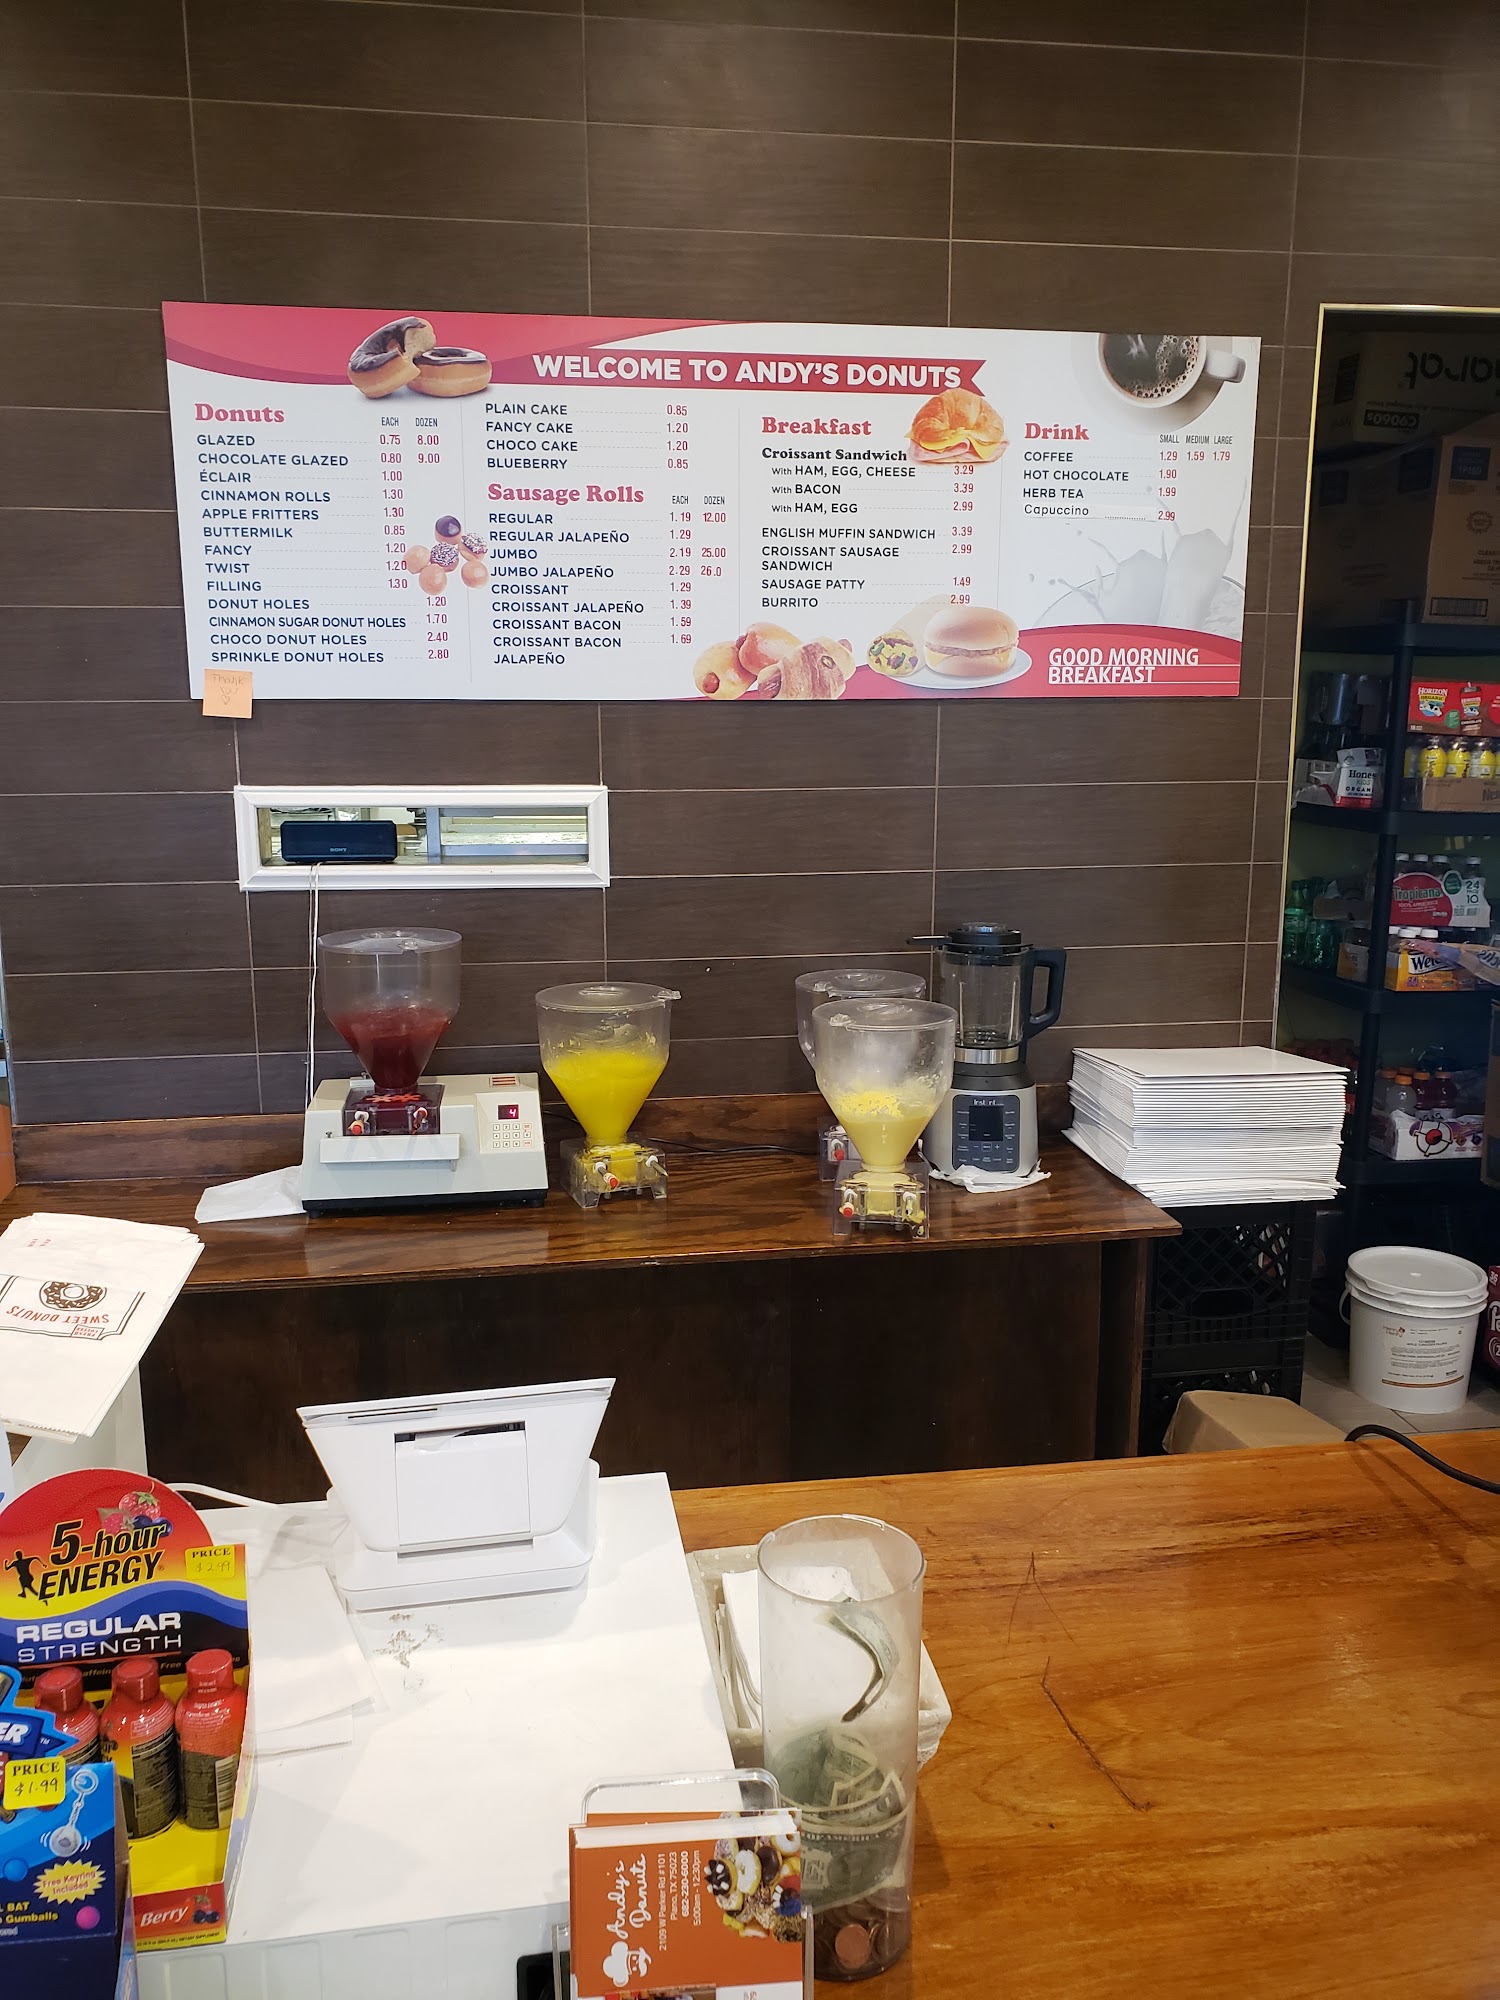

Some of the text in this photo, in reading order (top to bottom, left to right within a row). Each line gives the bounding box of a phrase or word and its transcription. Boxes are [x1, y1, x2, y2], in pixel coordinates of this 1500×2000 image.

[533, 355, 961, 388] WELCOME TO ANDY'S DONUTS
[195, 403, 284, 422] Donuts
[486, 404, 688, 416] PLAIN CAKE 0.85
[381, 417, 438, 427] EACH DOZEN
[762, 417, 872, 435] Breakfast
[1025, 422, 1089, 440] Drink
[197, 434, 439, 446] GLAZED 0.75 8.00
[1160, 435, 1233, 445] SMALL MEDIUM LARGE
[198, 452, 440, 466] CHOCOLATE GLAZED 0.80 9.00
[762, 448, 907, 460] Croissant Sandwich
[1024, 451, 1230, 462] COFFEE 1.29 1.59 1.79
[488, 458, 688, 469] BLUEBERRY 0.85
[200, 469, 402, 482] ÉCLAIR 1.00
[795, 466, 827, 478] HAM,
[831, 466, 862, 478] EGG,
[866, 467, 916, 477] CHEESE
[954, 465, 974, 475] 3.29
[1024, 469, 1177, 481] HOT CHOCOLATE 1.90
[488, 484, 644, 506] Sausage Rolls
[772, 483, 974, 494] With BACON 3.39
[1023, 487, 1176, 498] HERB TEA 1.99
[672, 496, 725, 505] EACH DOZEN
[795, 503, 827, 515] HAM,
[831, 504, 858, 513] EGG
[953, 502, 973, 511] 2.99
[1025, 504, 1176, 522] Capuccino 2.99
[489, 512, 726, 524] REGULAR 1.19 12.00
[203, 525, 405, 538] BUTTERMILK 0.85
[490, 530, 691, 543] REGULAR JALAPEÑO 1.29
[762, 526, 972, 539] ENGLISH MUFFIN SANDWICH 3.39
[205, 543, 406, 556] FANCY 1.20
[490, 548, 726, 559] JUMBO 2.19 25.00
[762, 544, 972, 557] CROISSANT SAUSAGE 2.99
[206, 560, 407, 574] TWIST 1.20
[491, 566, 722, 578] JUMBO JALAPEÑO 2.29 26.0
[762, 561, 832, 571] SANDWICH
[207, 579, 408, 592] FILLING 1.30
[491, 582, 691, 595] CROISSANT 1.29
[762, 577, 970, 589] SAUSAGE PATTY 1.49
[208, 596, 446, 610] DONUT HOLES 1.20
[762, 594, 970, 607] BURRITO 2.99
[209, 614, 447, 628] CINNAMON SUGAR DONUT HOLES 1.70
[493, 634, 692, 648] CROISSANT BACON 1.69
[212, 649, 449, 663] SPRINKLE DONUT HOLES 2.80
[494, 652, 565, 665] JALAPEÑO
[1049, 648, 1199, 666] GOOD MORNING
[1049, 667, 1155, 683] BREAKFAST
[1418, 687, 1448, 696] HORIZON
[1466, 880, 1480, 889] 24
[1393, 887, 1442, 901] Tropicana
[509, 1108, 517, 1118] 4
[6, 1306, 109, 1324] SWEET DONUTS
[51, 1519, 169, 1566] 5-hour
[192, 1547, 230, 1558] PRICE
[38, 1550, 164, 1600] ENERGY
[16, 1612, 182, 1644] REGULAR
[18, 1634, 182, 1663] STRENGTH
[13, 1762, 60, 1777] PRICE
[15, 1778, 58, 1796] $1.99
[43, 1870, 96, 1888] Free Keyring
[52, 1881, 89, 1894] Included
[670, 1881, 678, 1893] TX
[607, 1859, 630, 1940] Andy's
[7, 1902, 29, 1911] BAT
[6, 1912, 58, 1923] Gumballs
[141, 1905, 188, 1927] Berry
